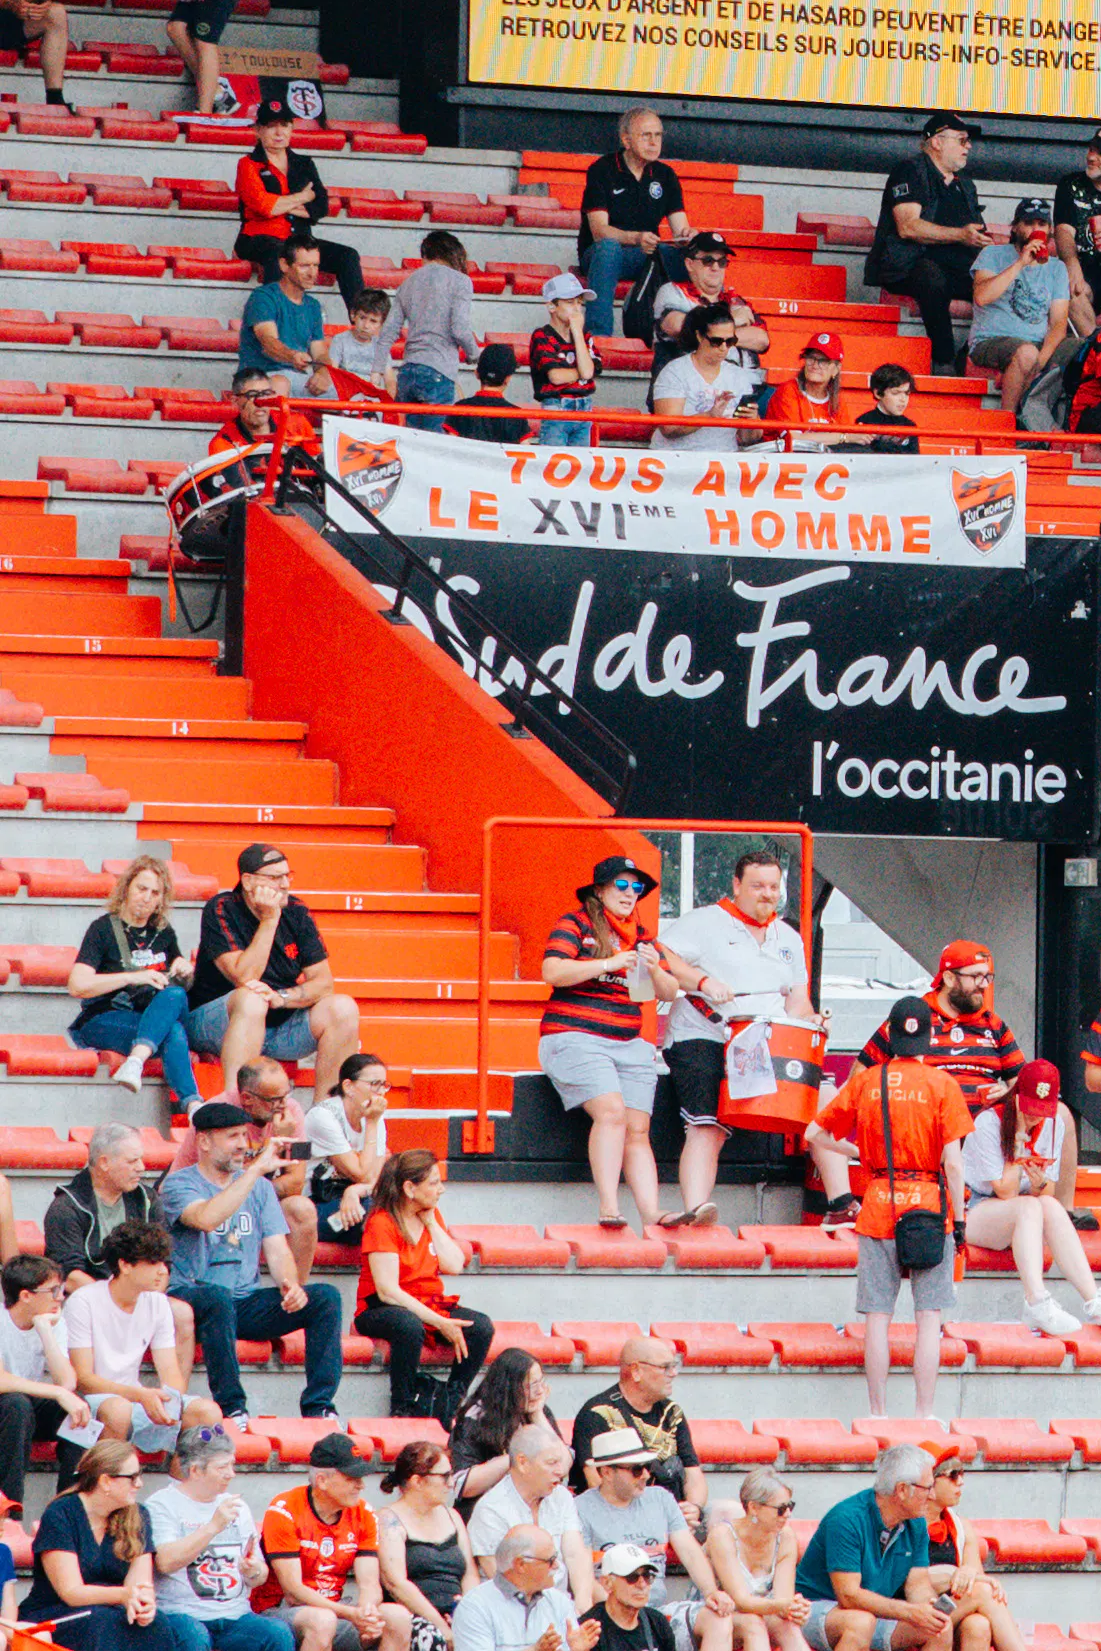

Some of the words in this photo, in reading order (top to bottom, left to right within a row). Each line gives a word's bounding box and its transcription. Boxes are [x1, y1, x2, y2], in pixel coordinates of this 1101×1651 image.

[717, 0, 739, 20] ET
[748, 1, 774, 22] DE
[781, 3, 866, 29] HASARD
[873, 8, 968, 35] PEUVENT
[973, 10, 1024, 38] ÊTRE
[501, 16, 627, 43] RETROUVEZ
[633, 25, 678, 46] NOS
[684, 27, 788, 53] CONSEILS
[794, 34, 836, 57] SUR
[241, 54, 303, 70] TOULOUSE
[778, 301, 798, 314] 20
[504, 450, 666, 495] TOUS
[692, 461, 850, 502] AVEC
[429, 486, 499, 531] LE
[704, 508, 932, 555] HOMME
[1039, 523, 1057, 535] 17
[593, 602, 725, 699] de
[732, 565, 1068, 729] France
[171, 722, 189, 736] 14
[811, 740, 1068, 804] l'occitanie
[345, 895, 364, 911] 12
[436, 983, 453, 998] 11
